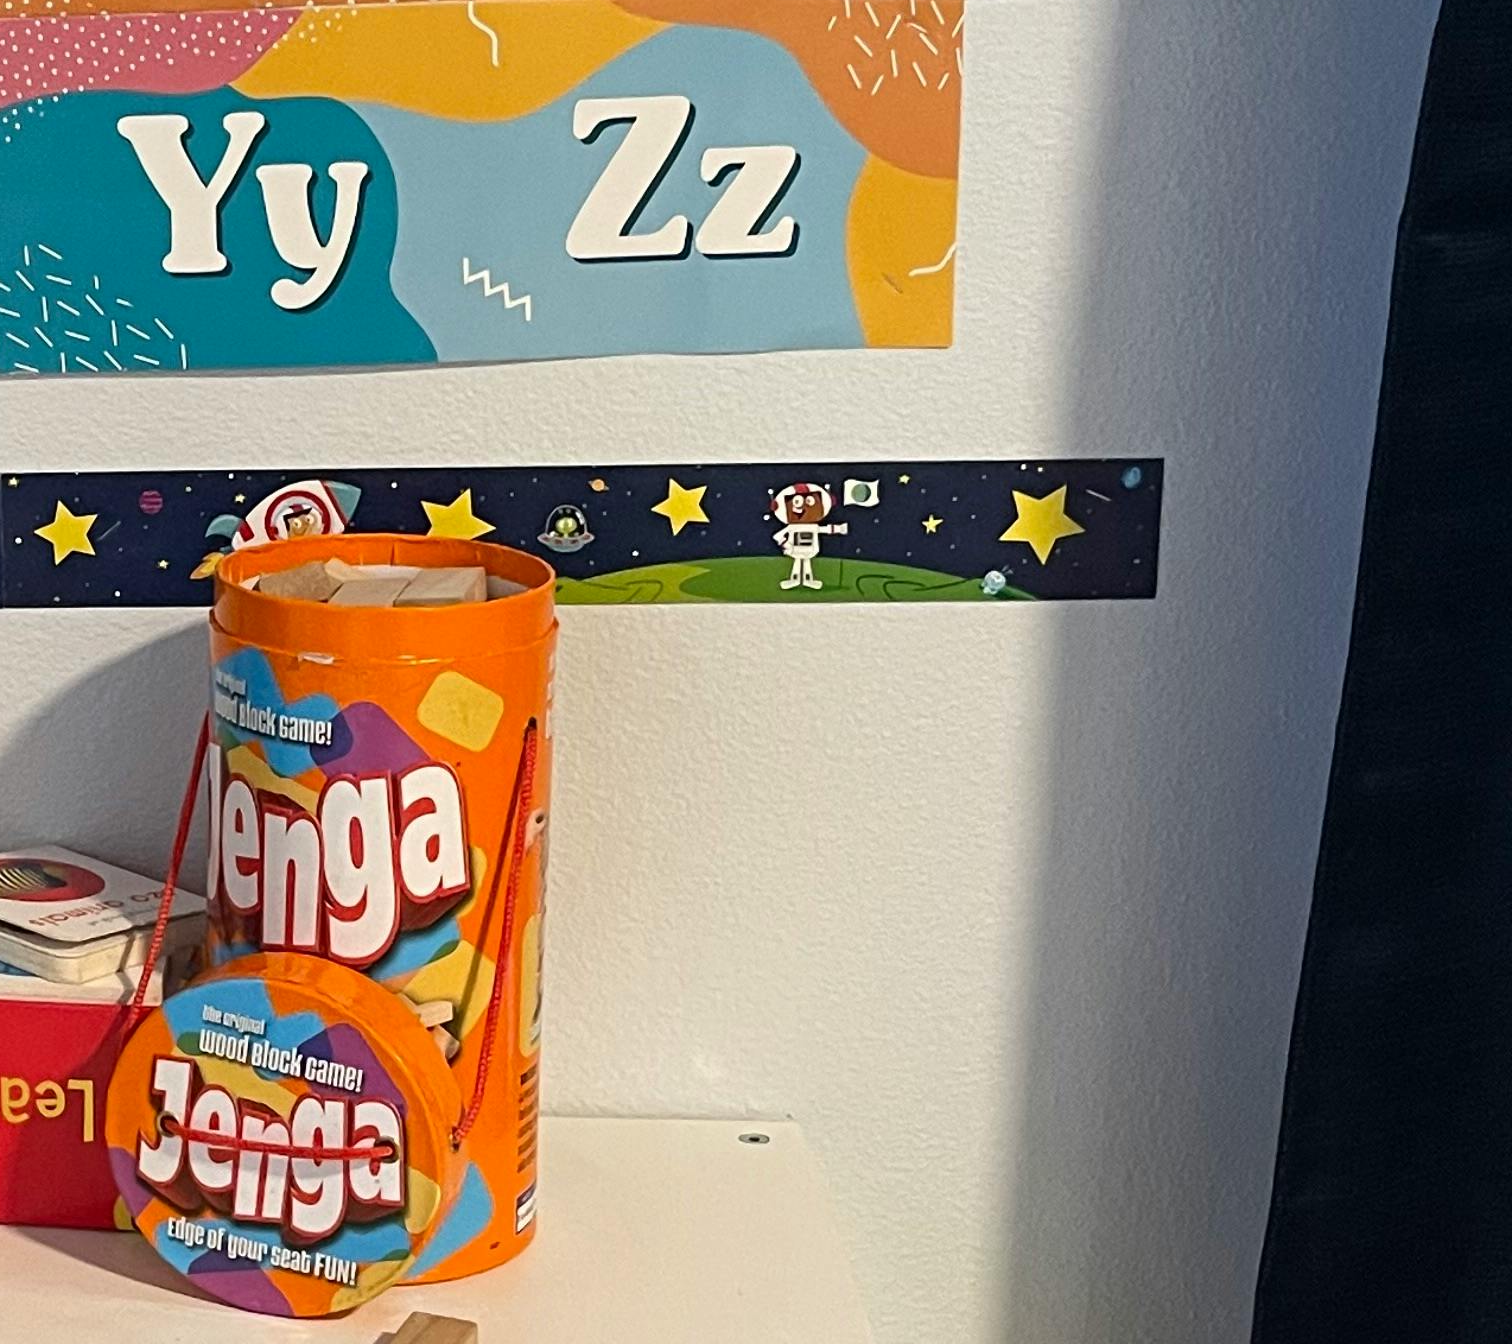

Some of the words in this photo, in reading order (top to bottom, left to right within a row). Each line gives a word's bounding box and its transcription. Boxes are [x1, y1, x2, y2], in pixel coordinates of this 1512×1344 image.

[117, 111, 370, 310] Yy
[565, 96, 801, 259] Zz
[138, 1056, 404, 1238] Jenga
[167, 1216, 205, 1250] Edge
[206, 1229, 224, 1253] of
[227, 1235, 268, 1263] your
[313, 1252, 358, 1286] FUN!
